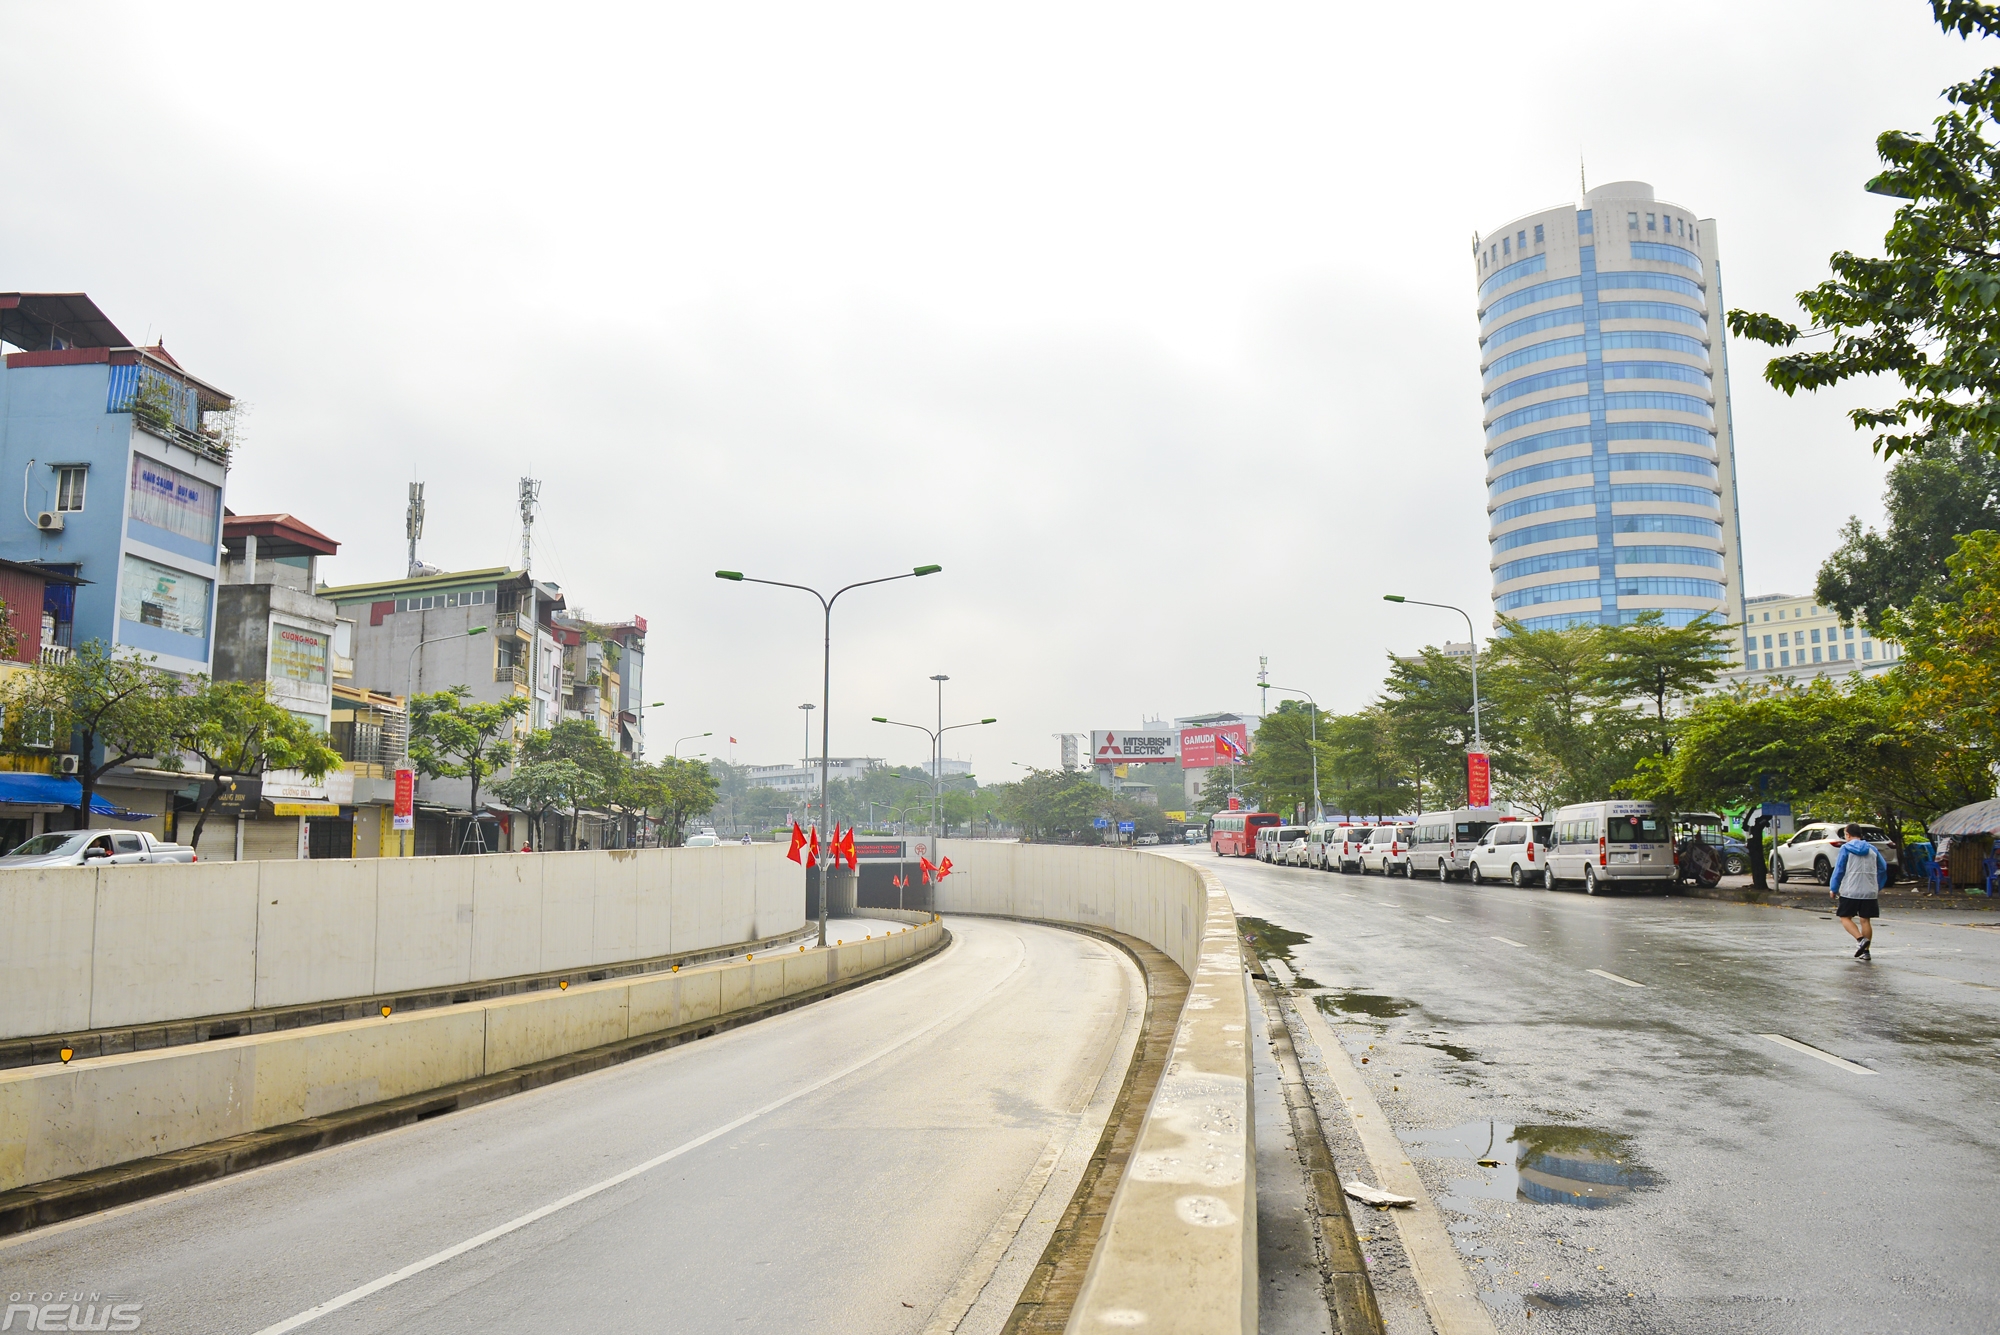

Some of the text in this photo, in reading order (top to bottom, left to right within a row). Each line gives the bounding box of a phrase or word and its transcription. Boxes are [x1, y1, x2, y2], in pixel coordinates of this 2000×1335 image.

[142, 470, 156, 484] HAIR
[156, 475, 174, 492] SALON
[1123, 736, 1171, 746] MITSUBISHI
[1184, 734, 1215, 746] GAMUDA
[1123, 746, 1164, 755] ELECTRIC
